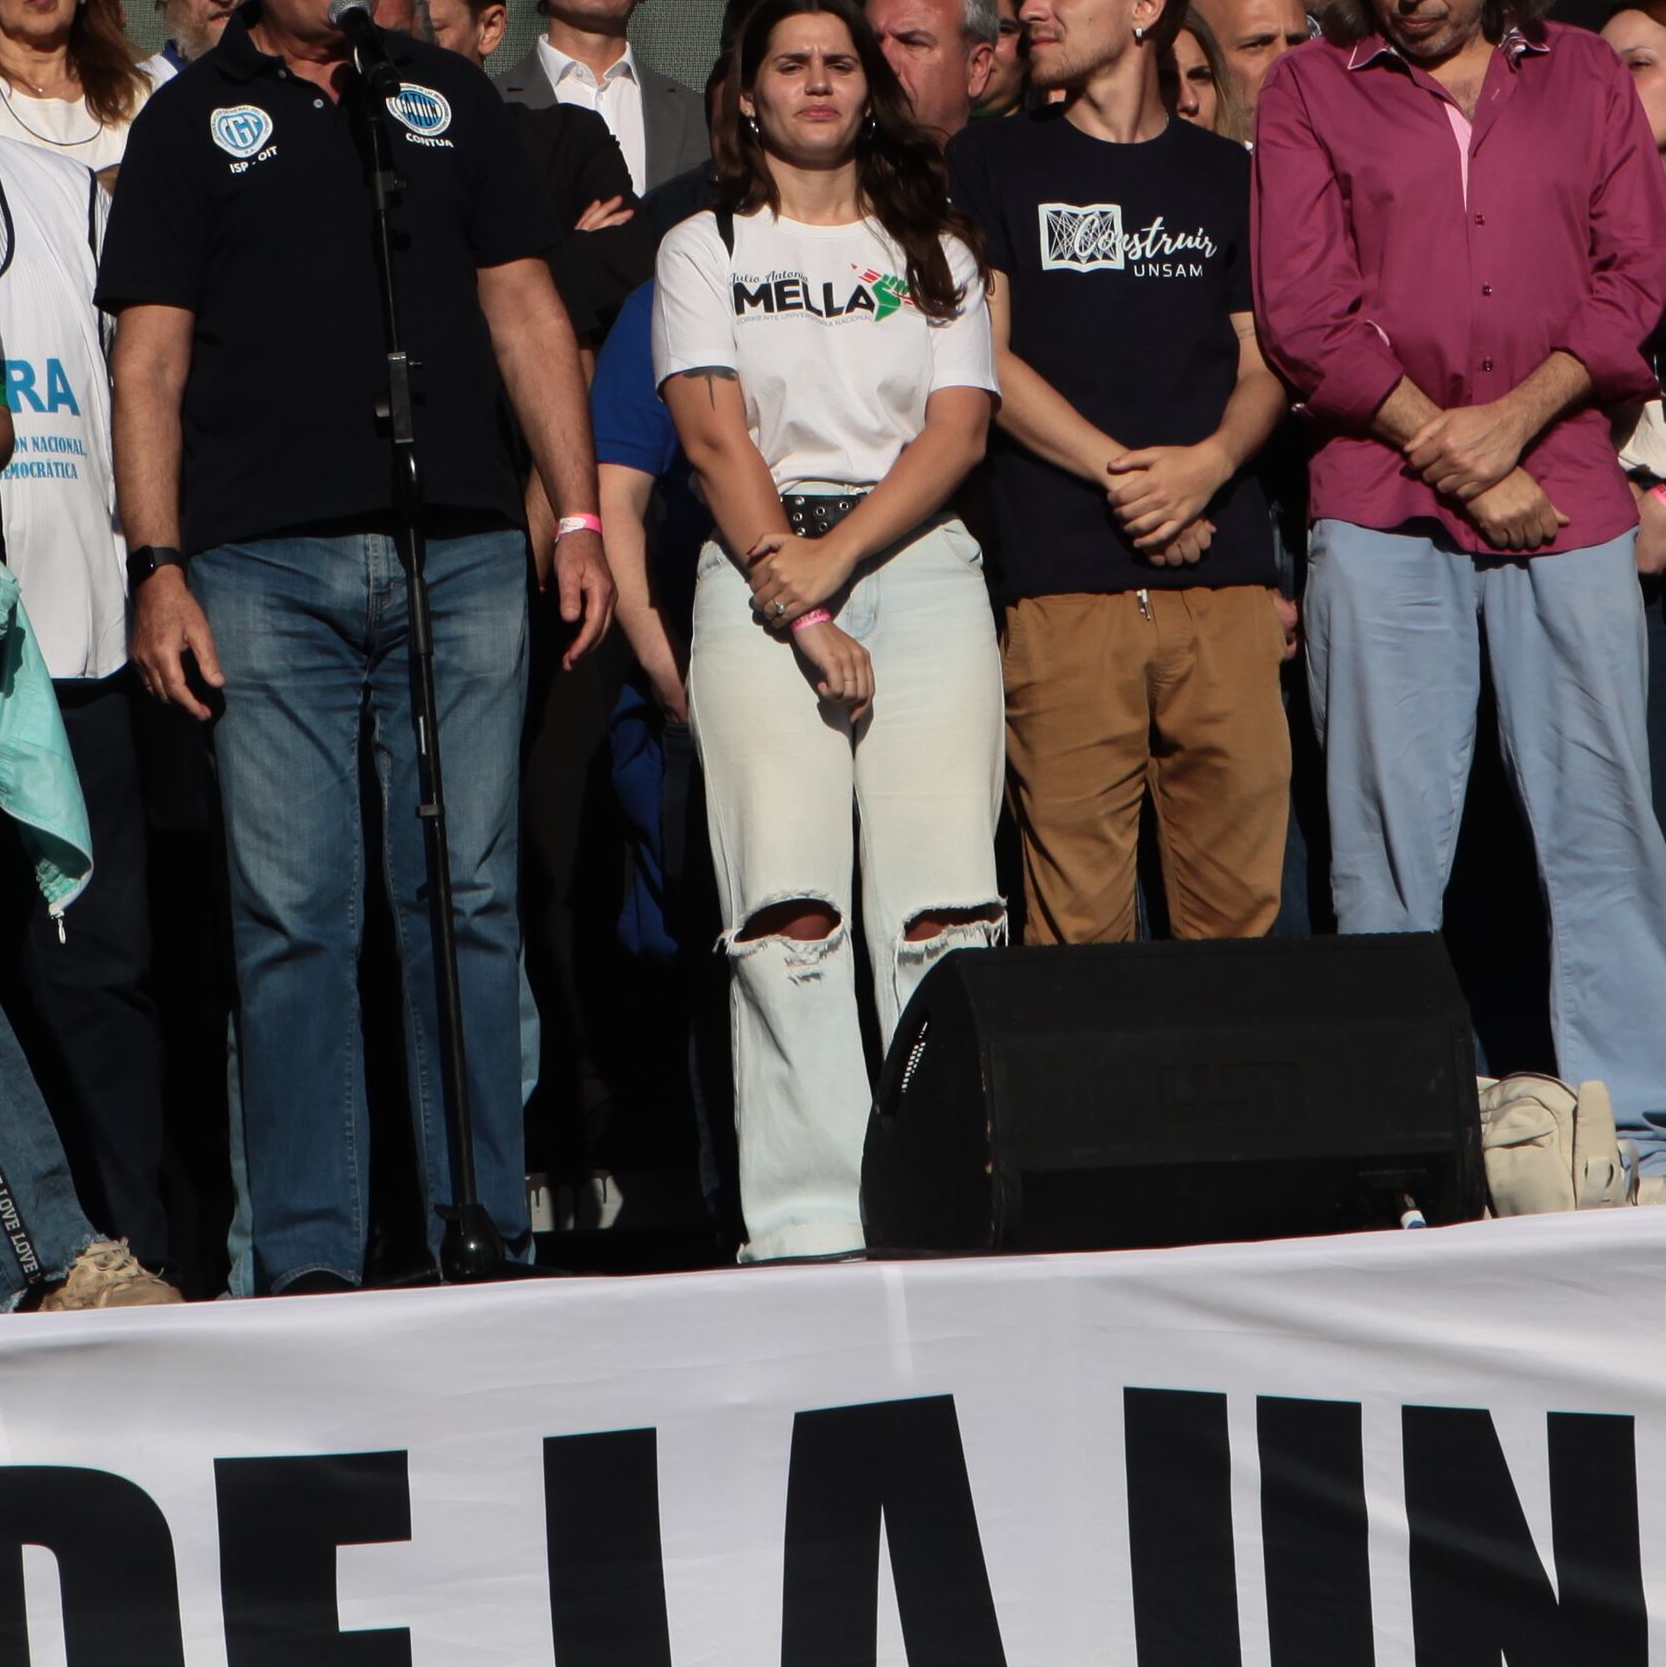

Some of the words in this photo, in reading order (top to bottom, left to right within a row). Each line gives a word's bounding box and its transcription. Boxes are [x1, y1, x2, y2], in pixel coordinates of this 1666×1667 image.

[405, 133, 454, 149] CONTUA
[229, 161, 249, 174] ISP
[258, 145, 278, 162] OIT
[1074, 215, 1218, 261] Construir
[1134, 264, 1203, 278] UNSAM
[733, 279, 876, 318] MELLA
[33, 436, 89, 459] NACIONAL,
[10, 1232, 39, 1274] LOVE
